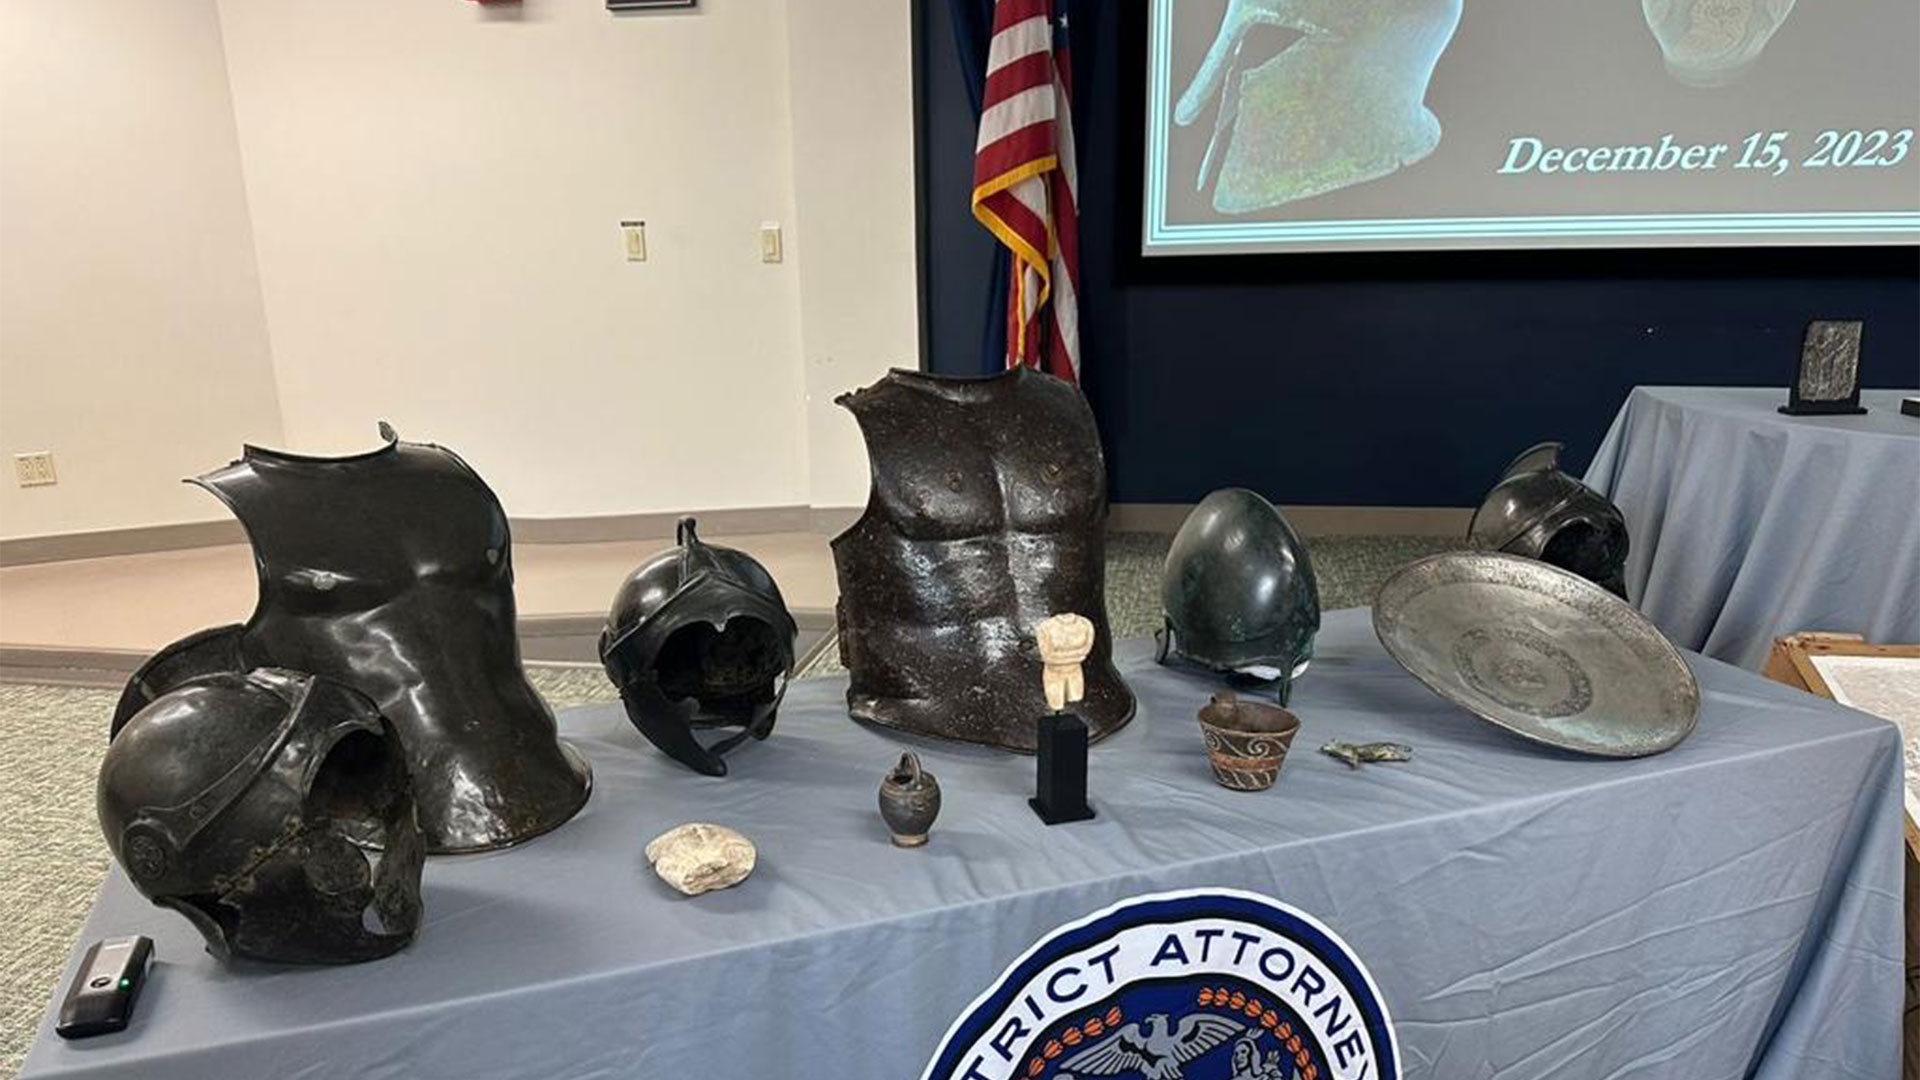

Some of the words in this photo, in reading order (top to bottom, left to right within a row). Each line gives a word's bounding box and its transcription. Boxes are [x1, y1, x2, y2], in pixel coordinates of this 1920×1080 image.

[1497, 134, 1729, 174] December
[1734, 131, 1789, 176] 15,
[1802, 128, 1915, 168] 2023
